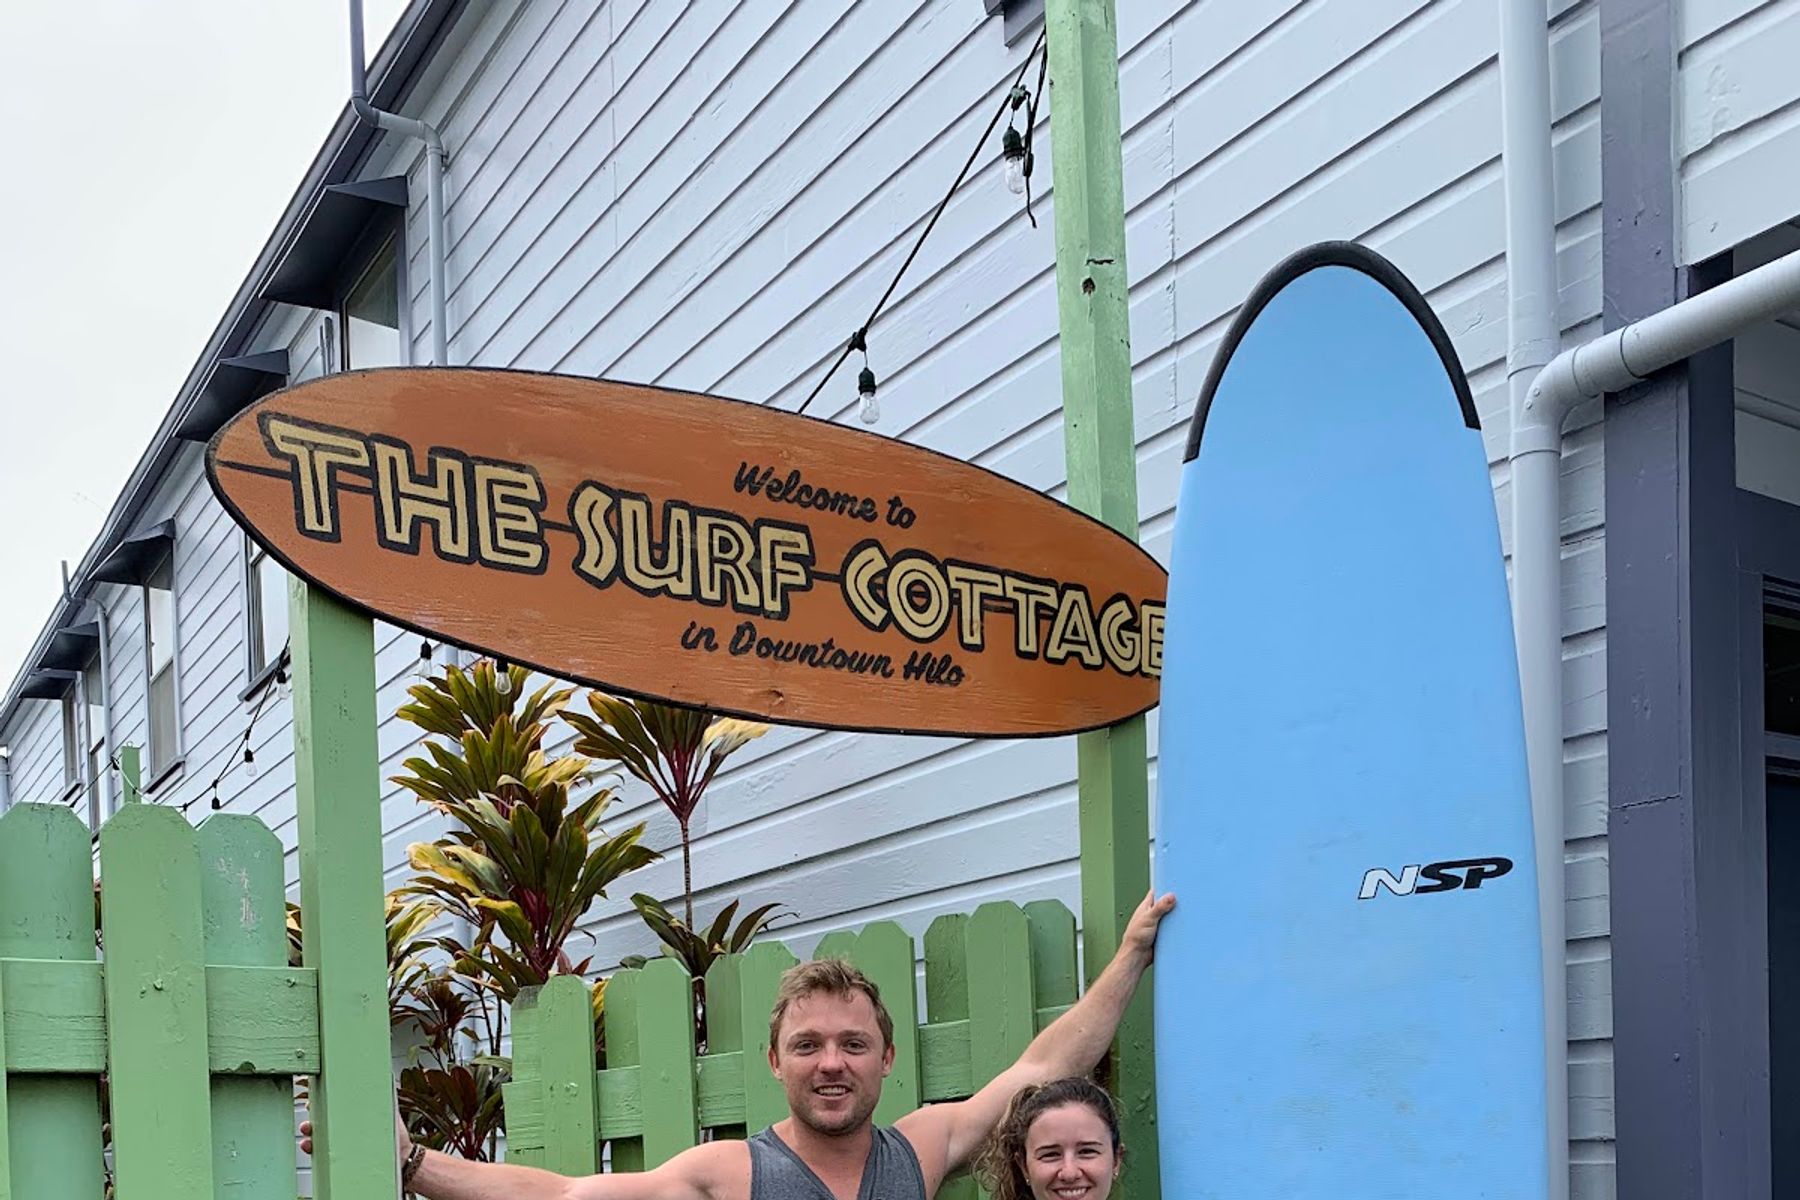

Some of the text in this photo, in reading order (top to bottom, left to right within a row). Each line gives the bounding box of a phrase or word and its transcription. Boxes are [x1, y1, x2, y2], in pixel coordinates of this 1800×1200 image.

[733, 460, 918, 530] Welcome to
[257, 411, 1167, 677] THE SURF COTTAGE
[681, 620, 966, 688] in Downtown Hilo
[1357, 856, 1514, 900] NSP
